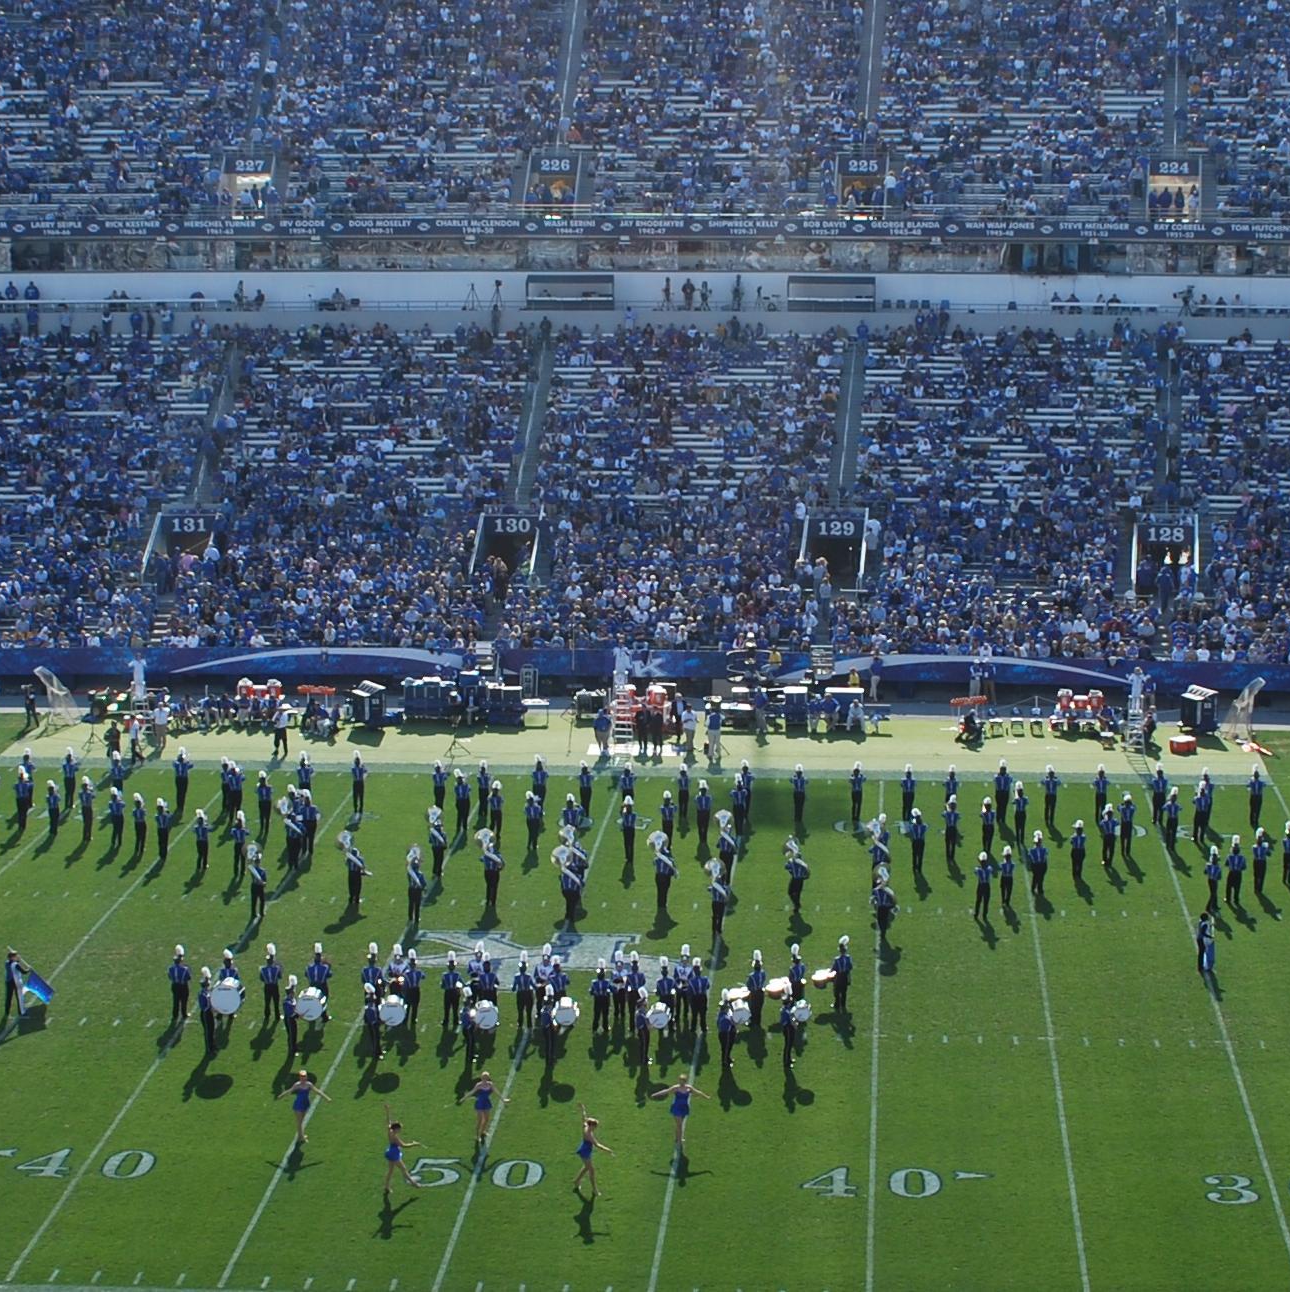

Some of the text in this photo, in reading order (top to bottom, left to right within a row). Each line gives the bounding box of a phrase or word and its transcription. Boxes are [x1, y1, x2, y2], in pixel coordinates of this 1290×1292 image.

[235, 160, 265, 172] 227
[541, 159, 570, 171] 226
[848, 160, 878, 172] 225
[1159, 162, 1189, 174] 224
[30, 221, 56, 229] LARRY
[184, 220, 256, 228] HERSCHEL TURNER
[280, 220, 325, 228] IRV GOODE
[348, 220, 412, 228] DOUG MOSELEY
[435, 220, 469, 228] CHARLIE
[543, 220, 568, 228] WASH
[620, 220, 634, 228] JAY
[708, 220, 779, 228] SHIPWRECK KELLY
[803, 221, 847, 229] BOB DAVIS
[871, 221, 940, 229] GEORGE BLANDA
[965, 222, 1035, 230] WAH WAH JONES
[1059, 222, 1082, 230] STEVE
[1154, 223, 1170, 231] RAY
[1231, 224, 1250, 233] TOM
[172, 518, 206, 532] 131
[494, 518, 530, 533] 130
[818, 521, 855, 536] 129
[1148, 527, 1184, 542] 128
[14, 1147, 157, 1179] 40
[406, 1157, 546, 1189] 50
[800, 1165, 942, 1198] 40
